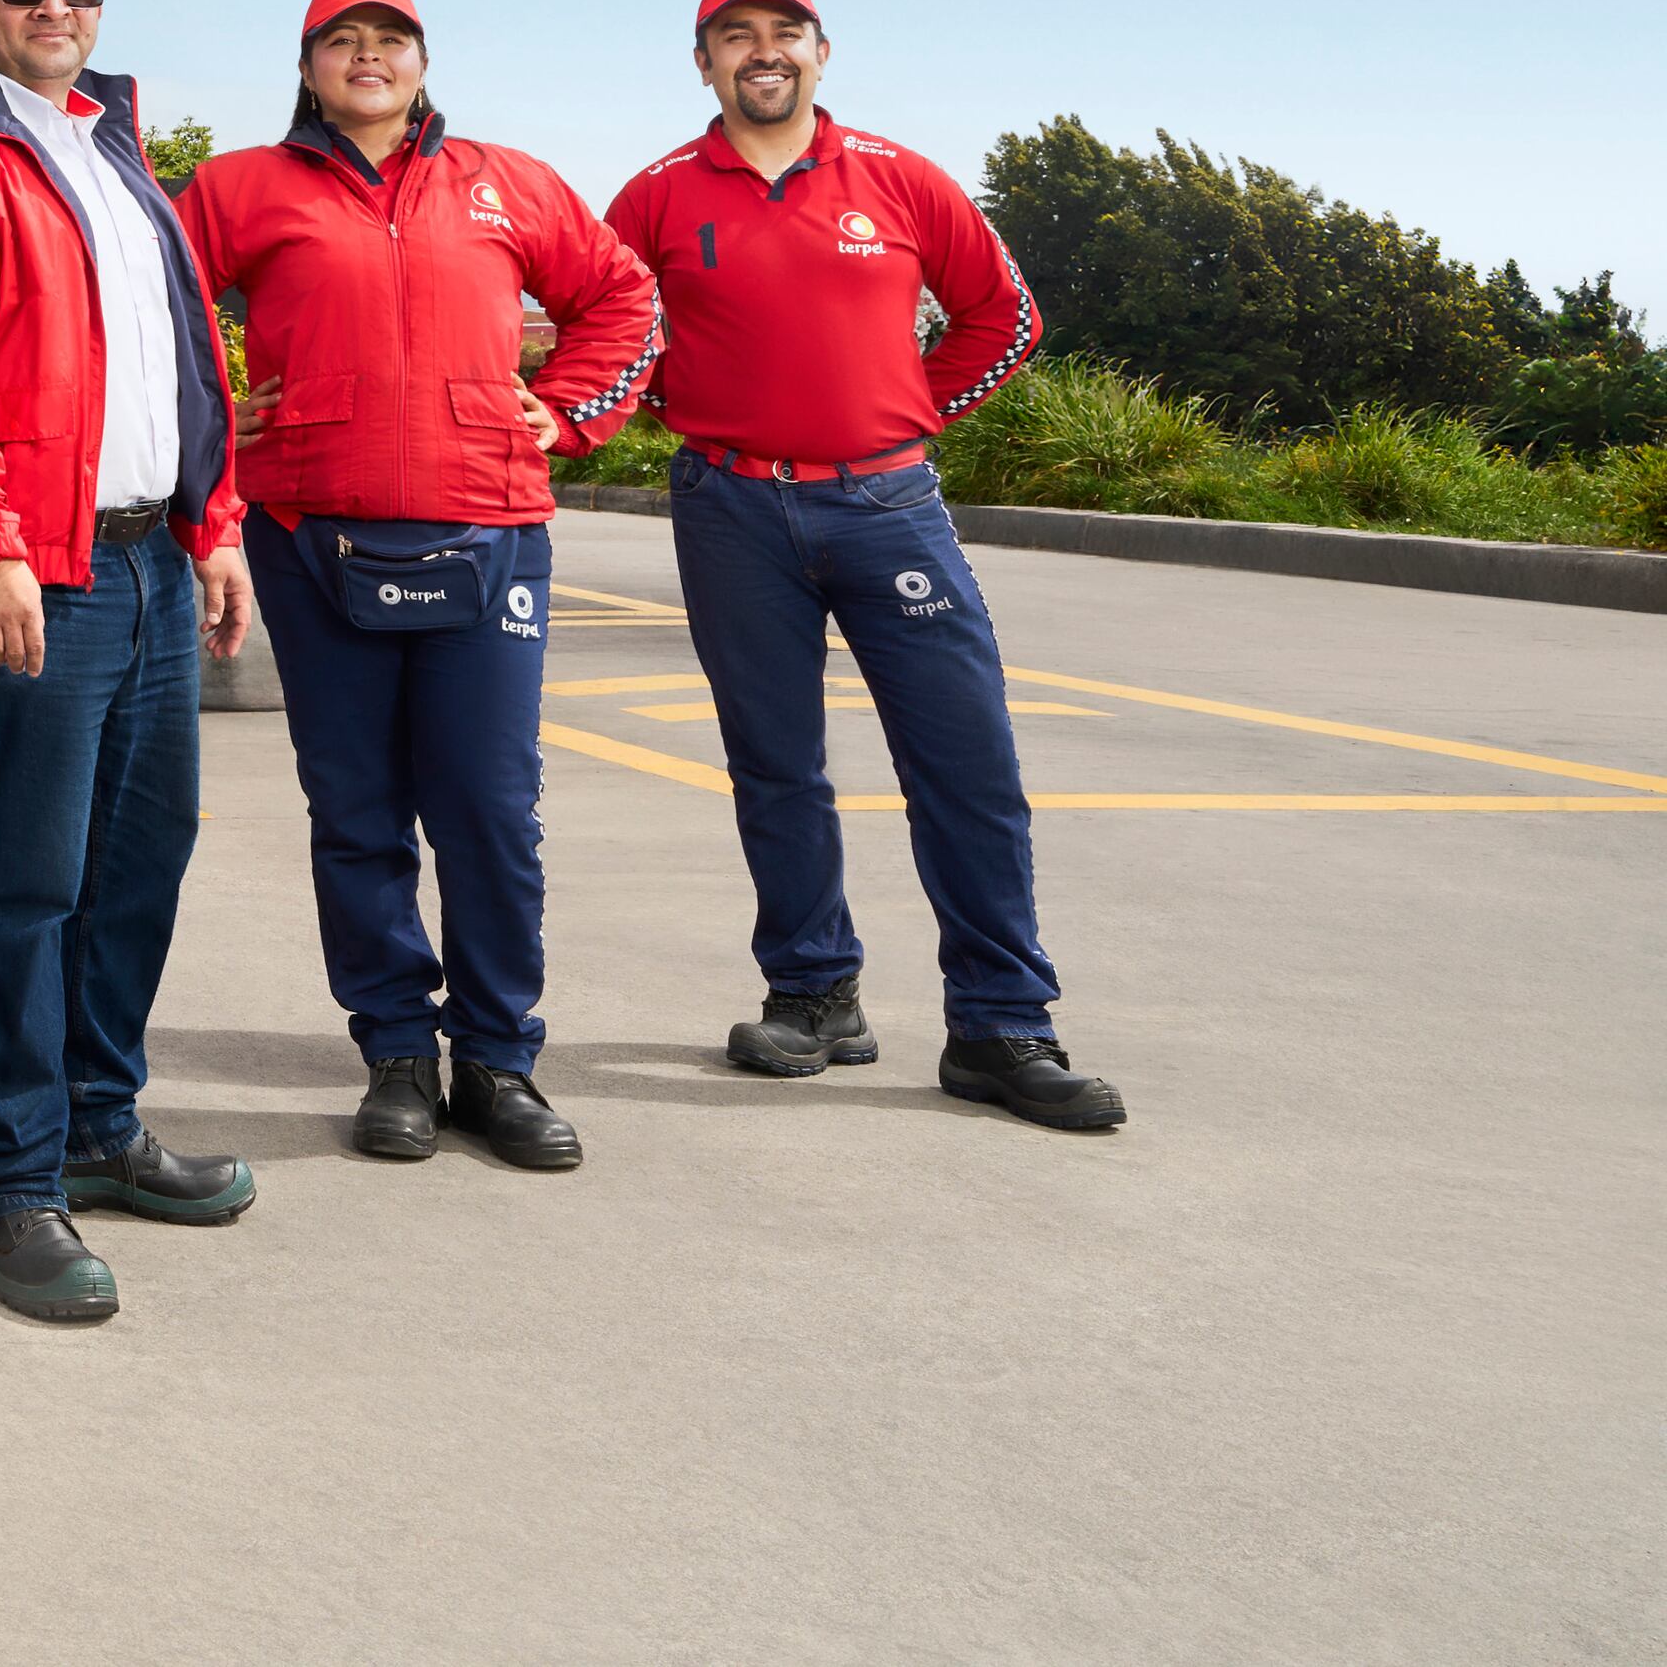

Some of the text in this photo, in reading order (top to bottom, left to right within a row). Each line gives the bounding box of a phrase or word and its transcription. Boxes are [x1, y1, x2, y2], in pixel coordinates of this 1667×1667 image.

[665, 150, 698, 166] altoque
[838, 241, 887, 257] terpel
[403, 589, 447, 603] terpel
[900, 596, 954, 617] terpel
[501, 617, 540, 638] terpel
